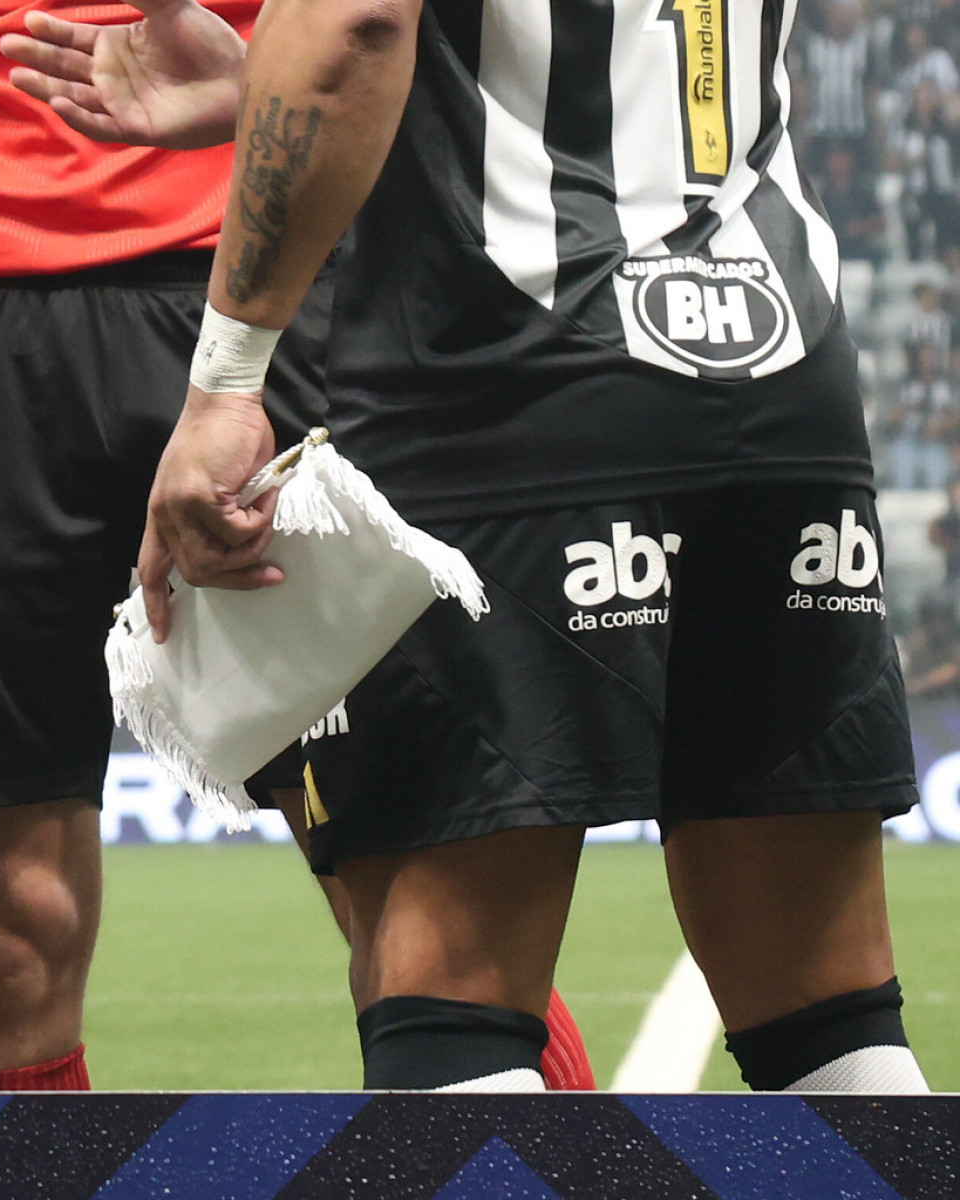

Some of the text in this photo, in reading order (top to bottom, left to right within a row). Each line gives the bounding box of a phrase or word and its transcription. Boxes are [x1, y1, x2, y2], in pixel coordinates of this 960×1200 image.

[665, 280, 754, 344] BH
[790, 509, 884, 594] ab
[568, 611, 597, 631] da
[786, 589, 886, 620] da constru
